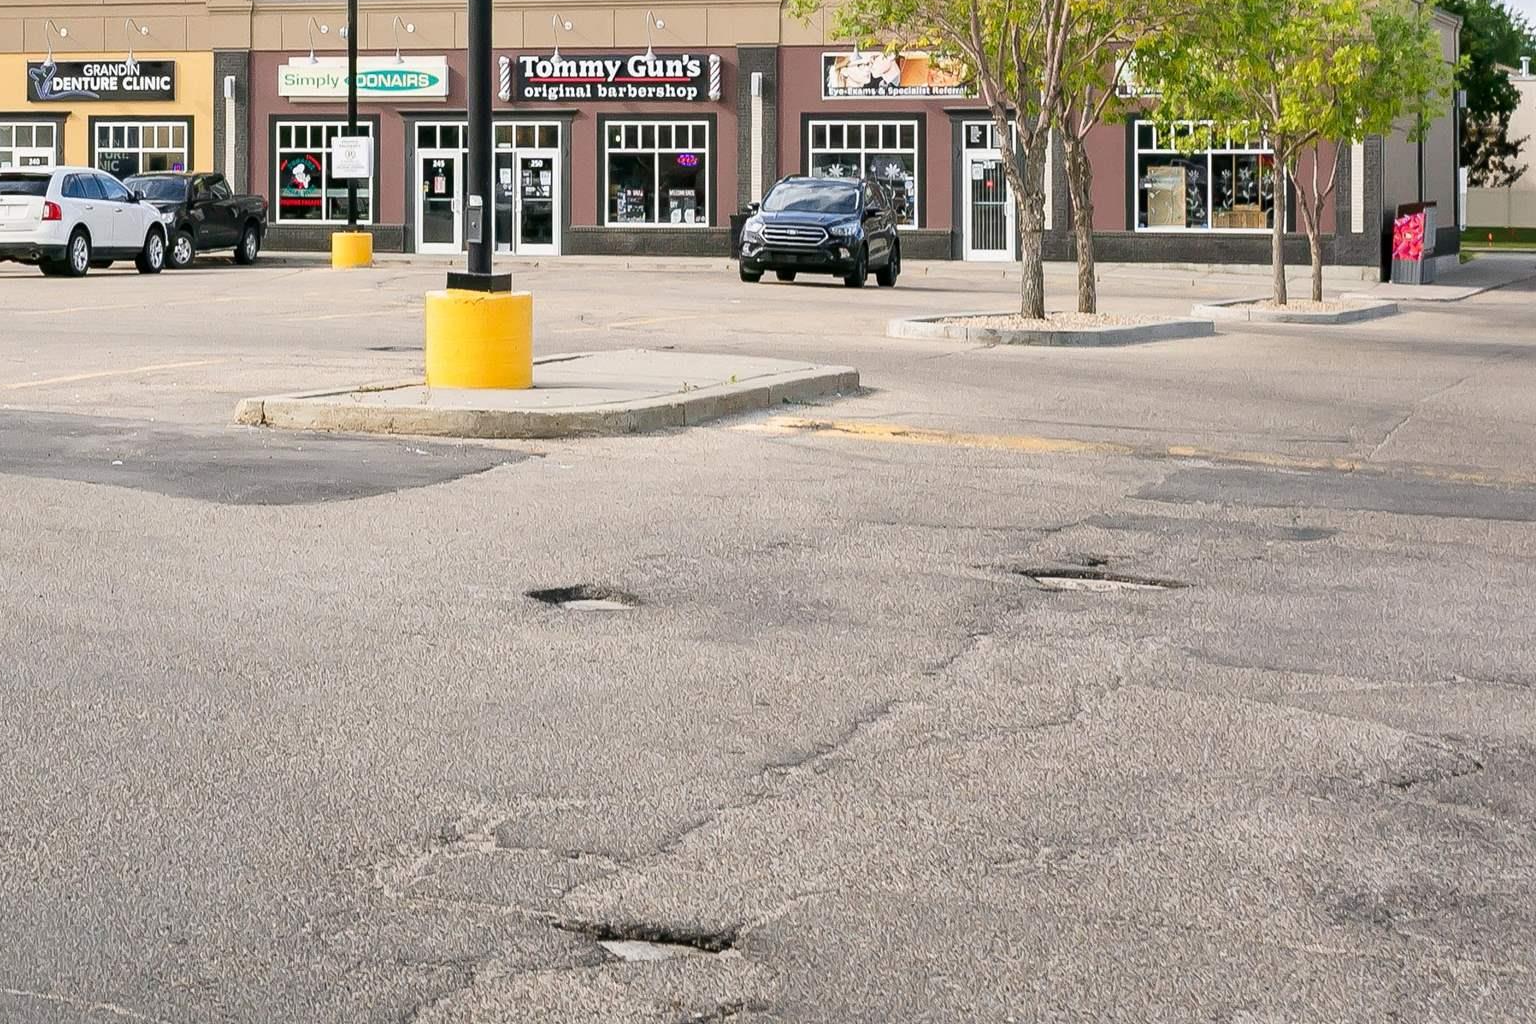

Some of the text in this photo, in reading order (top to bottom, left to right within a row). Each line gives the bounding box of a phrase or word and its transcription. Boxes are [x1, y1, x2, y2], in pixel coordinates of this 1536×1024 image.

[83, 64, 140, 76] GRANDIN
[519, 54, 701, 81] Tommy Gun's
[52, 76, 171, 90] DENTURE CLINIC
[284, 73, 430, 88] Simply DONAIRS
[524, 84, 698, 100] original barbershop
[888, 86, 930, 97] Specialist
